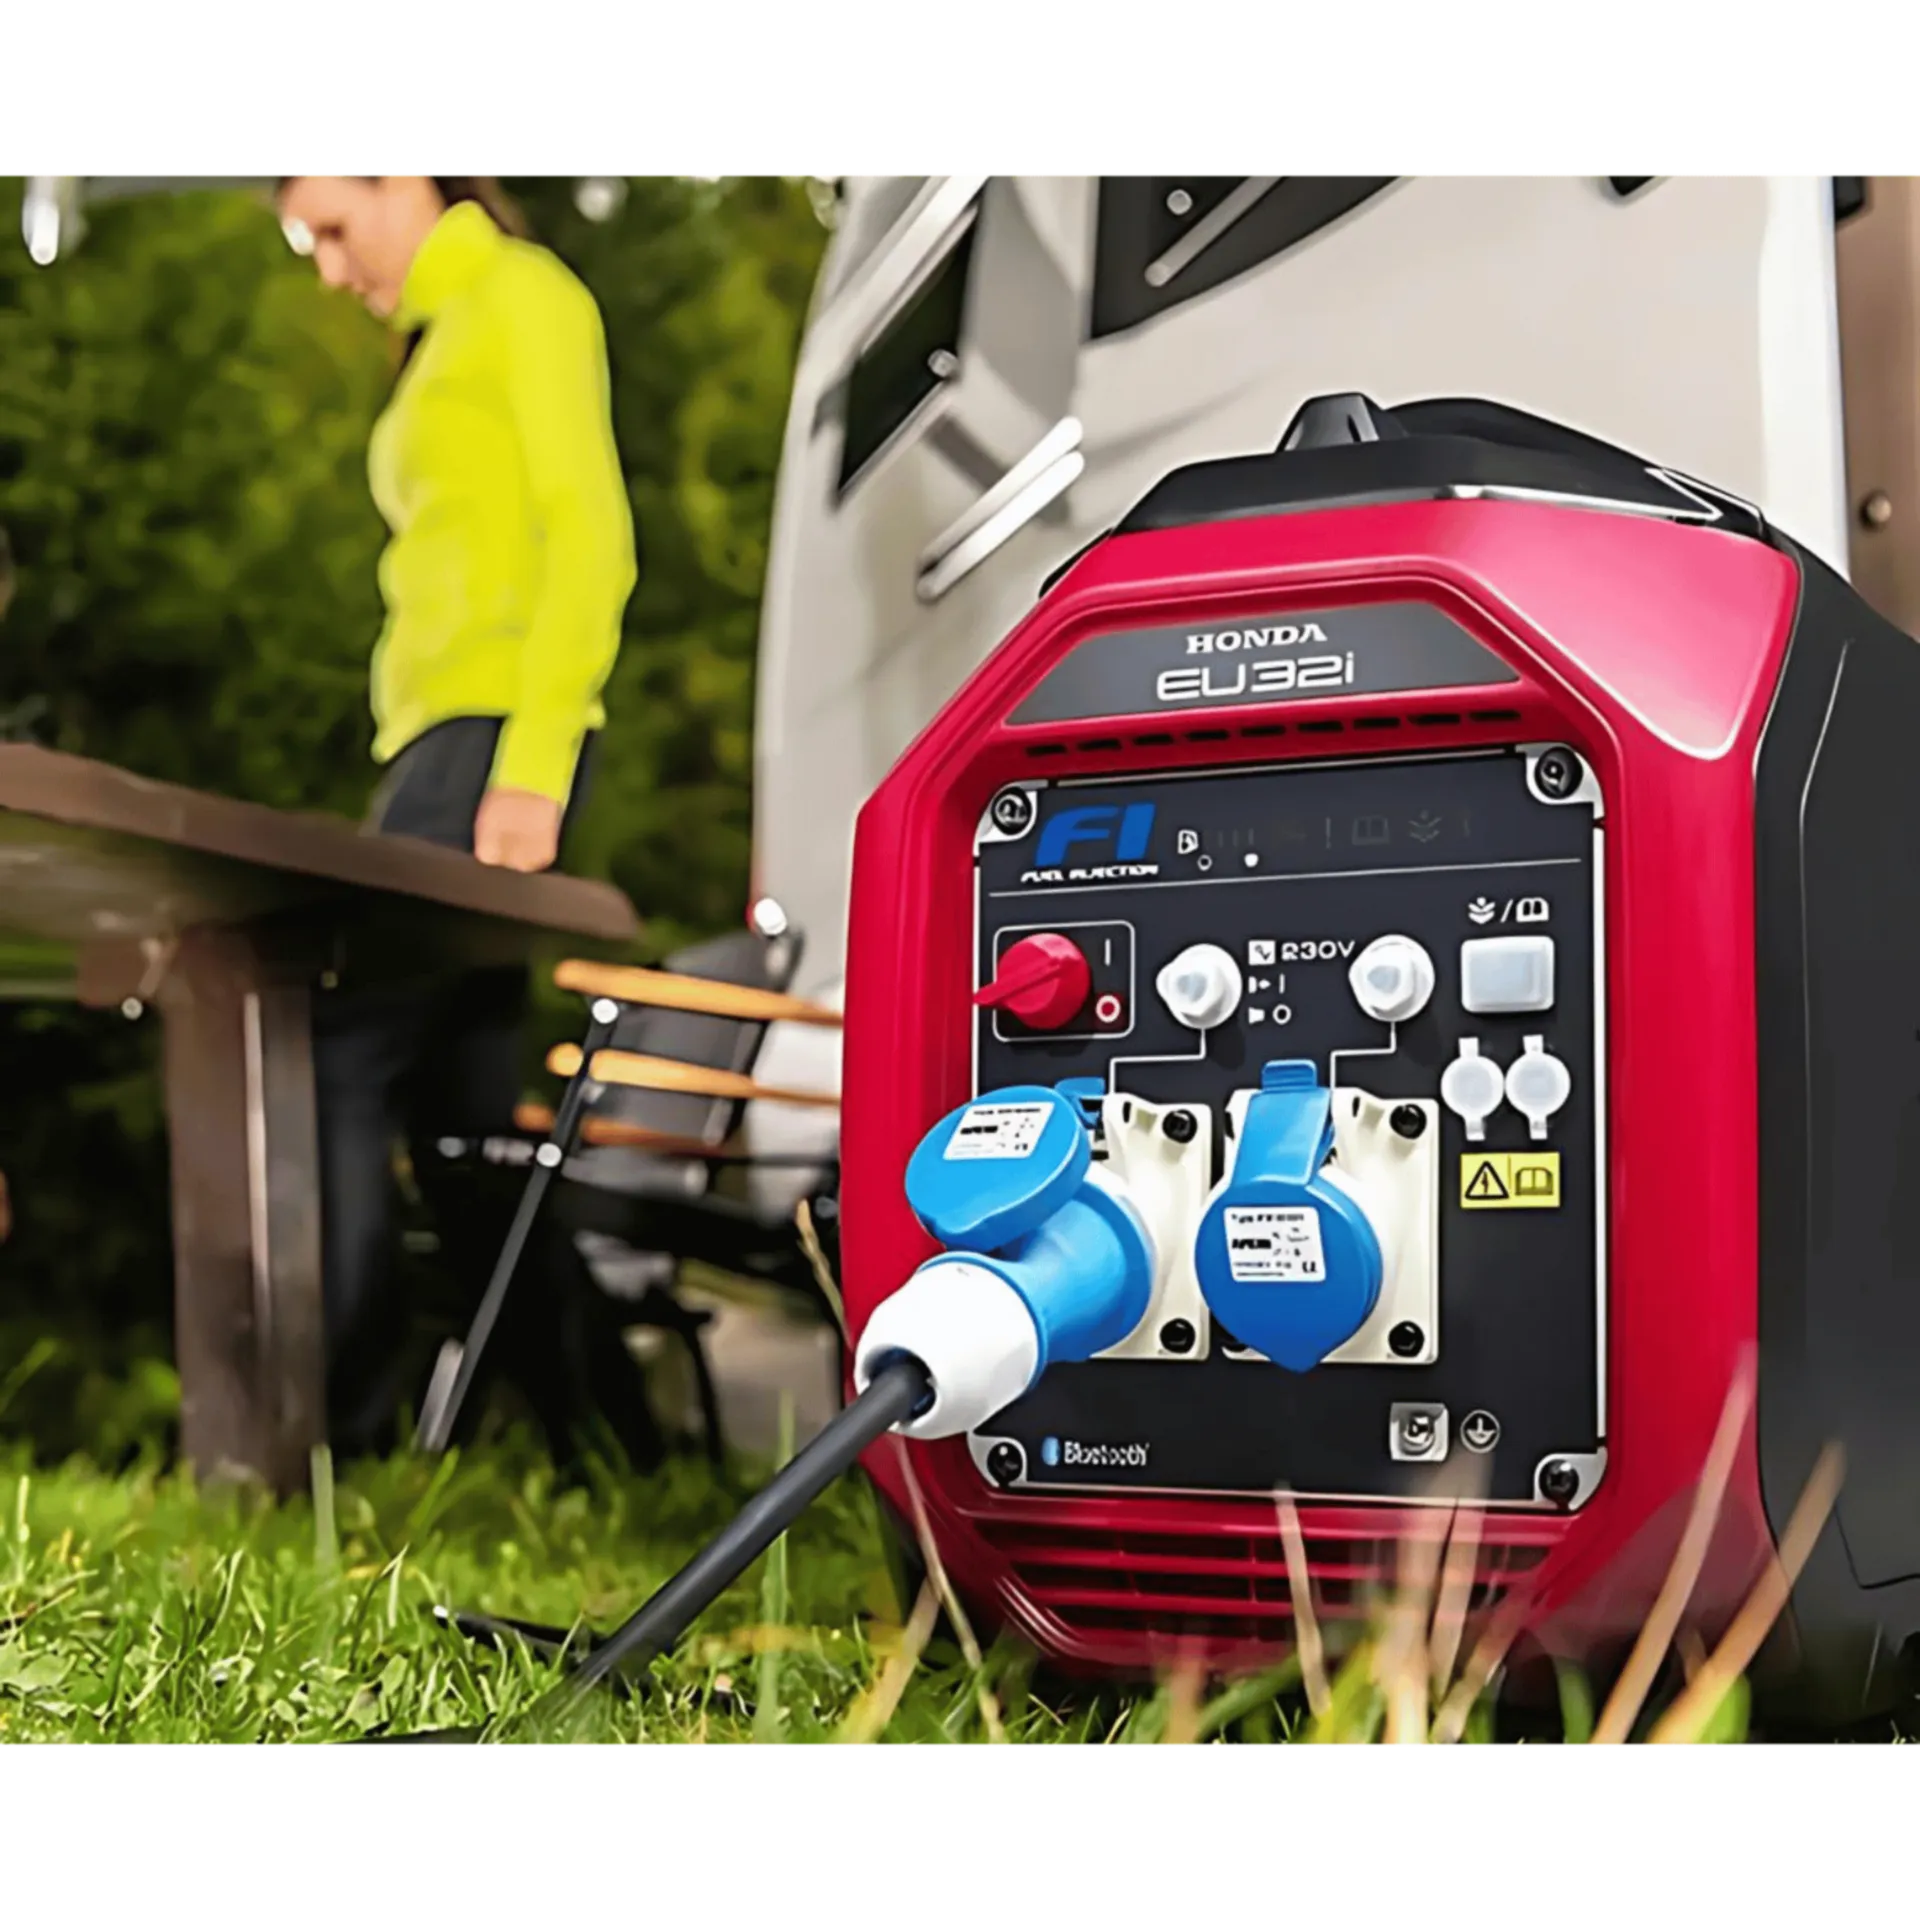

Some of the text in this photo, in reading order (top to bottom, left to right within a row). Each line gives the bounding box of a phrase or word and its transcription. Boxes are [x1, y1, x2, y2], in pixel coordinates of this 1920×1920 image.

[1186, 623, 1328, 654] HONDA
[1156, 651, 1355, 701] EU32i
[1034, 802, 1156, 867] FI
